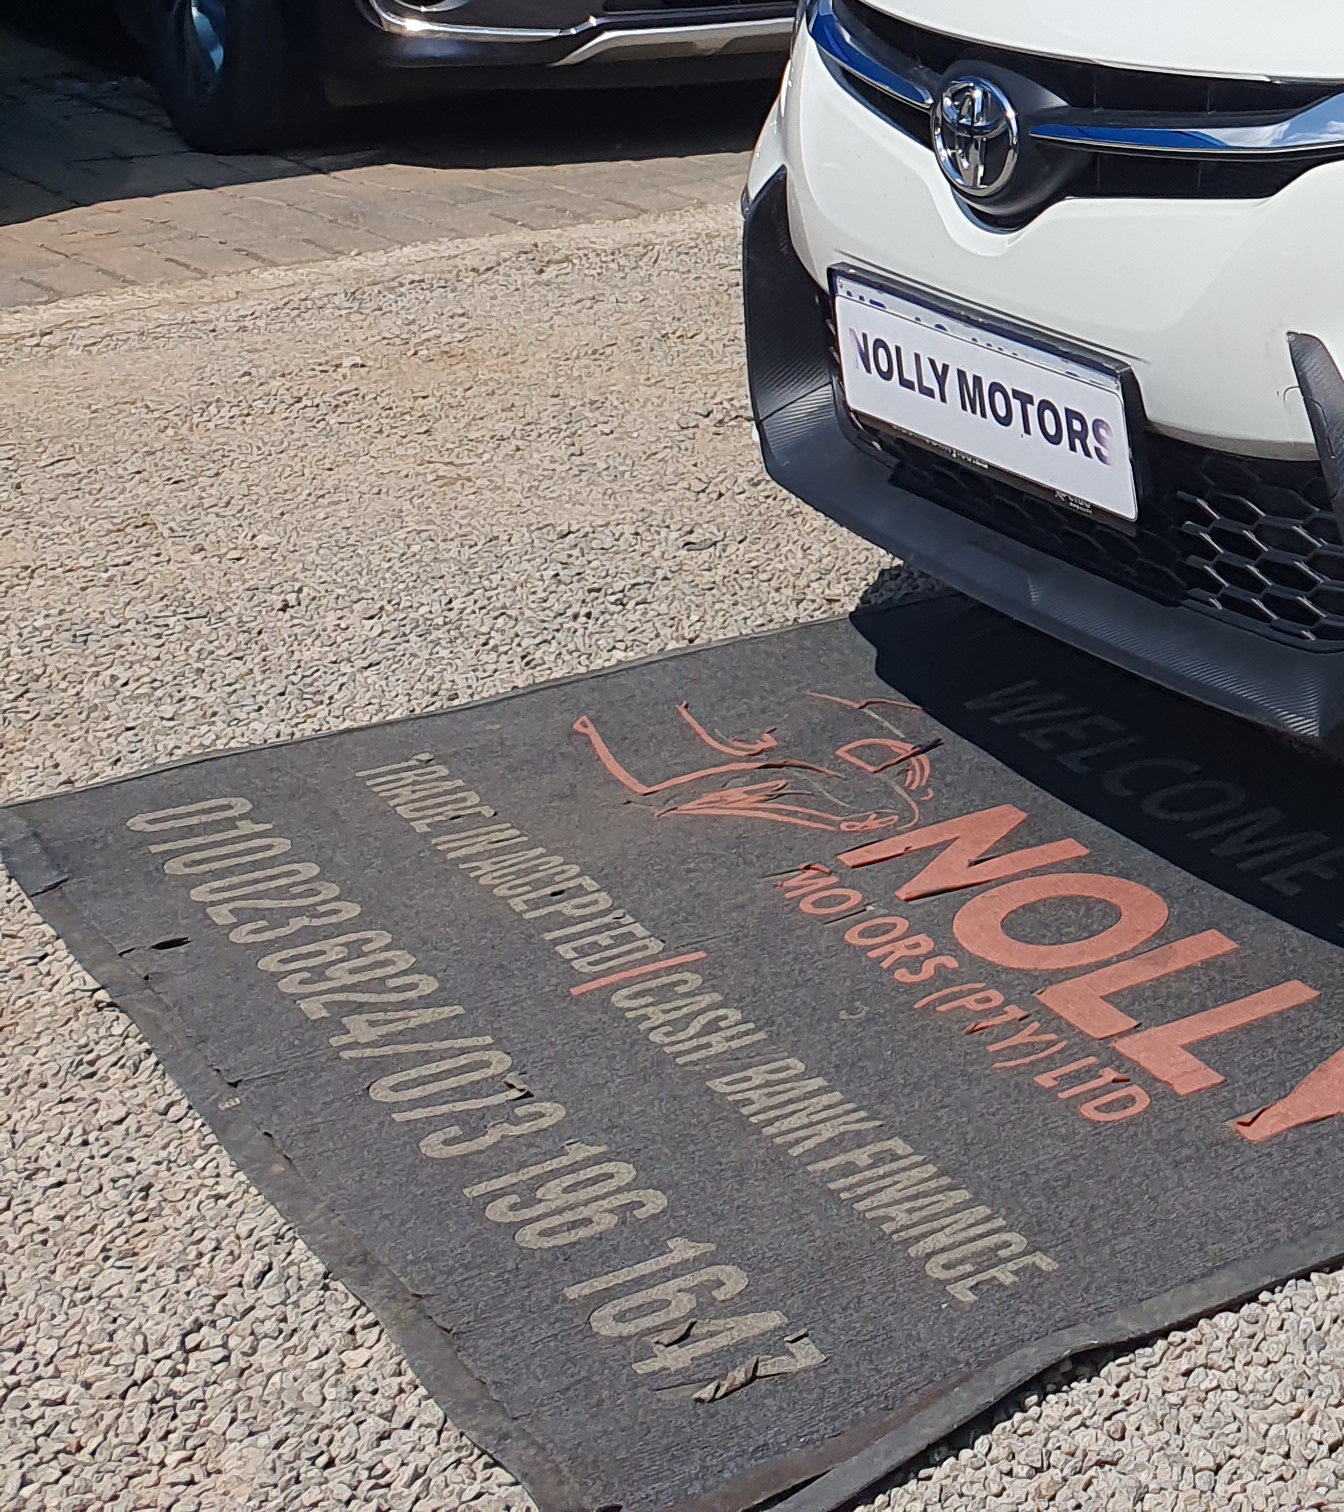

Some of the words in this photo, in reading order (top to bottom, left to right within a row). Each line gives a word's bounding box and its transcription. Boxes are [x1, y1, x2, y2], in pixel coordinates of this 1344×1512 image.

[848, 327, 951, 405] NOLLY
[955, 367, 1113, 467] MOTORS
[355, 751, 496, 833] TRADE
[431, 822, 529, 860] IN
[806, 1136, 1059, 1304] FINANCE
[775, 861, 959, 983] MOORS
[914, 982, 1068, 1069] (PTY)
[1033, 1056, 1151, 1123] LTD
[462, 1139, 668, 1249] 196
[563, 1236, 828, 1403] 1647
